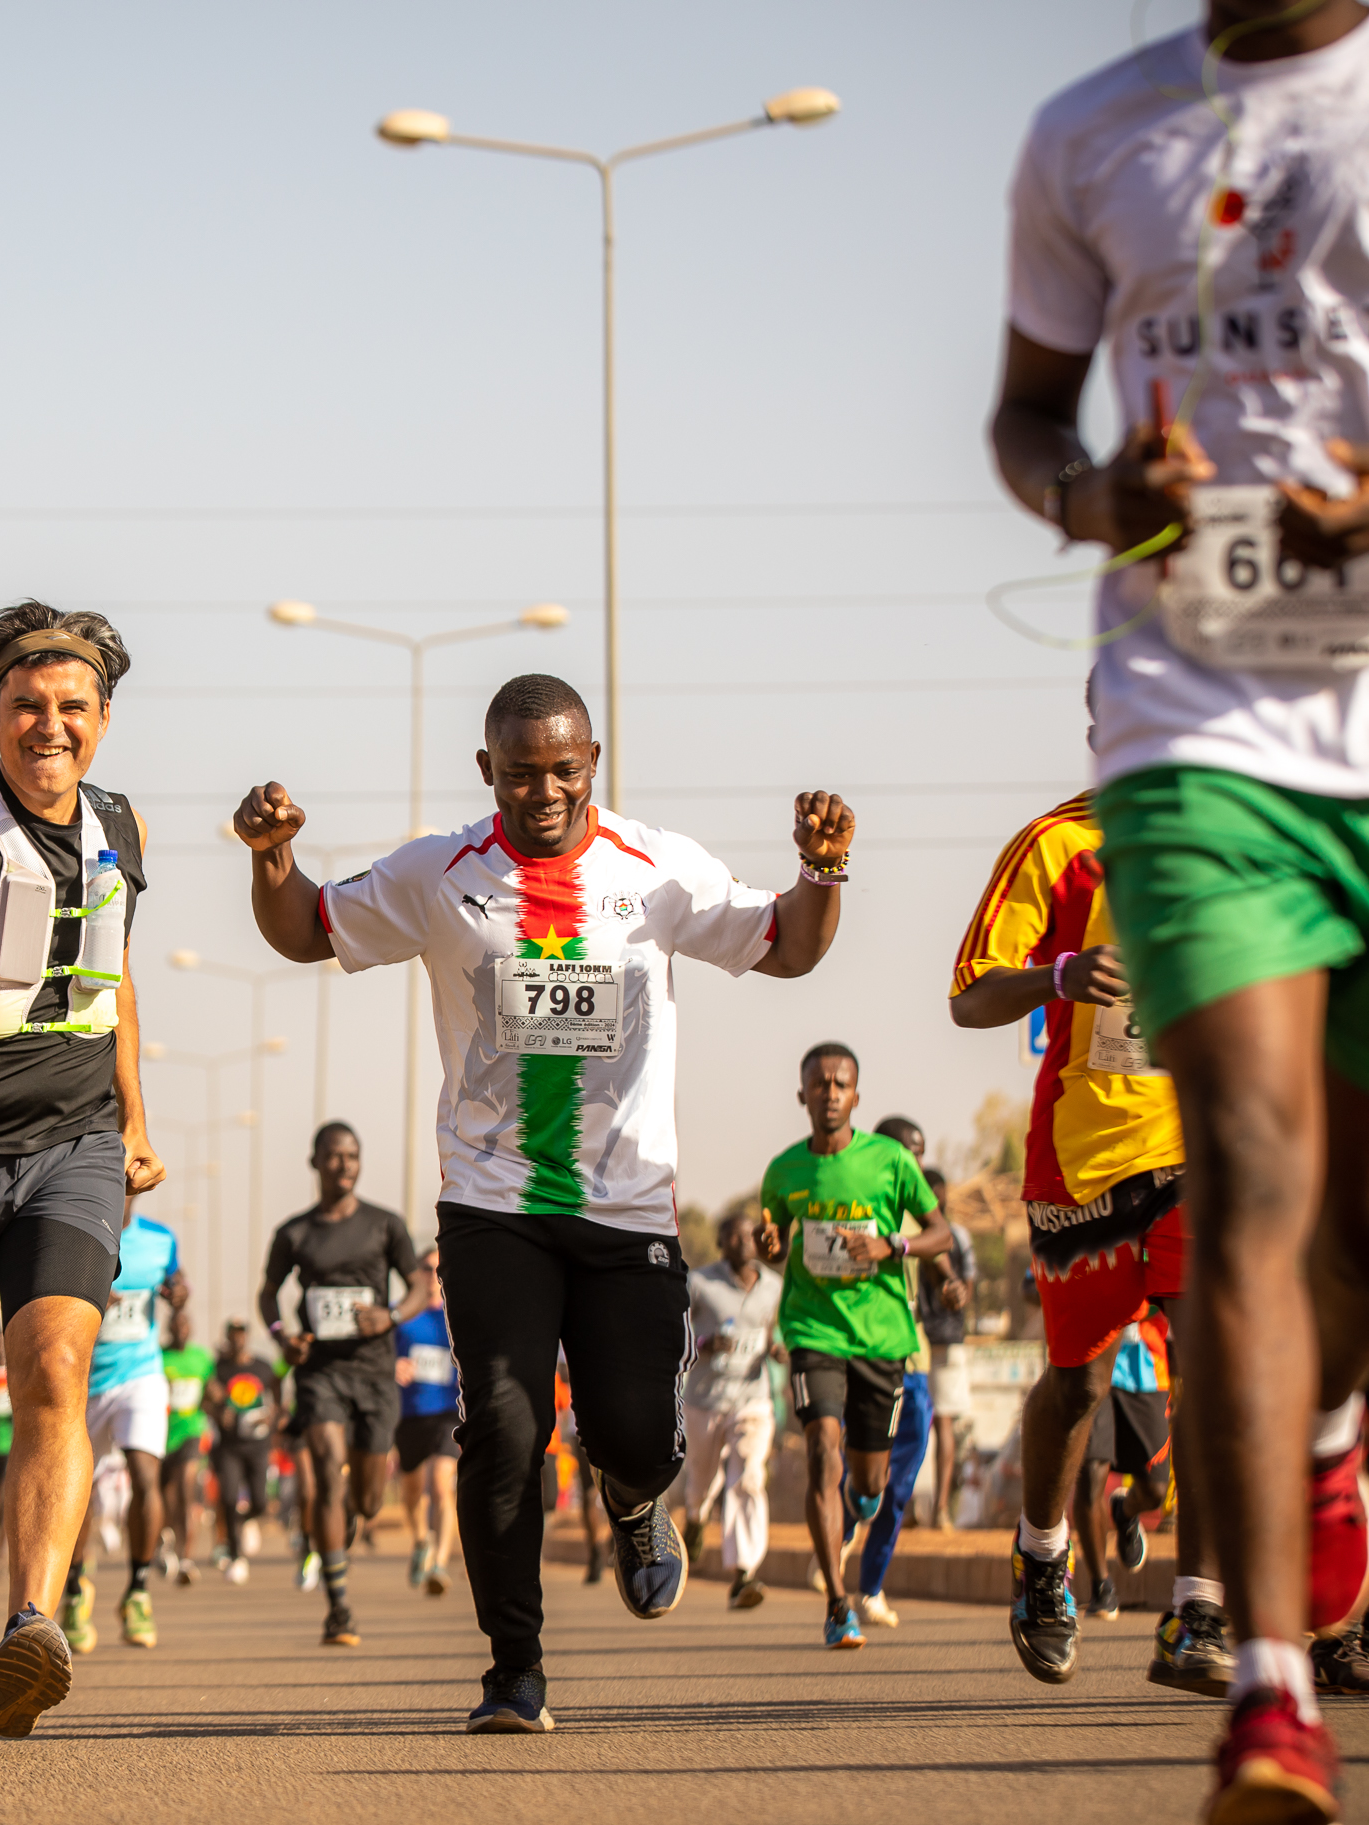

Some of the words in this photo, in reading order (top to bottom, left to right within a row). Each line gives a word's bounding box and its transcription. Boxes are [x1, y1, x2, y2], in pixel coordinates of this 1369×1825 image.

[1137, 304, 1369, 360] SUNSE
[549, 963, 576, 973] LAFI
[579, 964, 612, 974] 10KM
[568, 972, 614, 983] OUAGA
[524, 984, 596, 1017] 798
